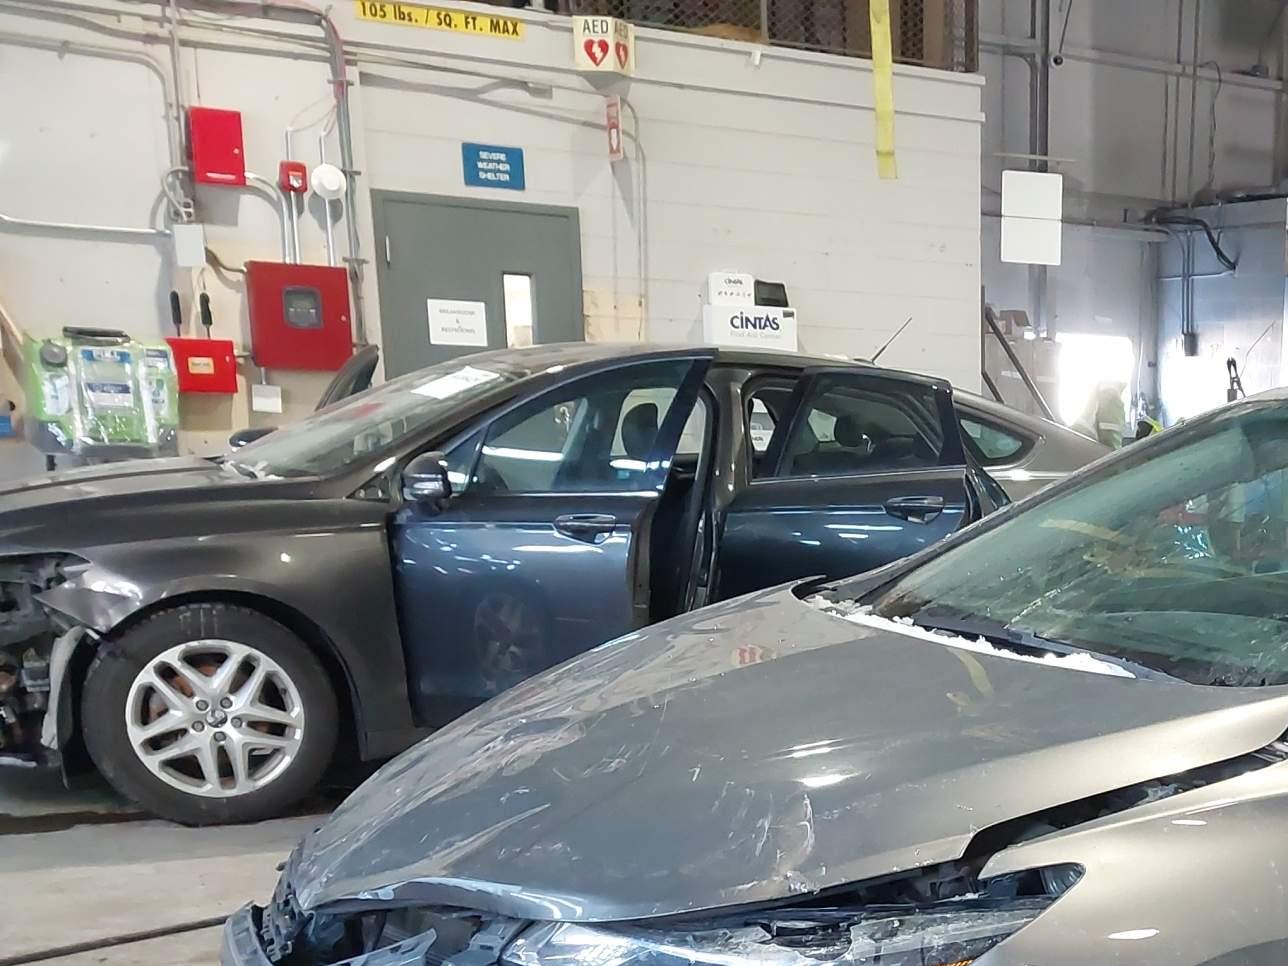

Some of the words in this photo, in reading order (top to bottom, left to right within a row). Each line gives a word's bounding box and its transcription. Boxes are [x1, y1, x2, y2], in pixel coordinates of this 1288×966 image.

[360, 1, 388, 18] 105
[393, 4, 418, 23] lbs.
[436, 11, 458, 28] SQ.
[464, 15, 483, 31] FT.
[489, 19, 520, 36] MAX
[583, 19, 609, 33] AED
